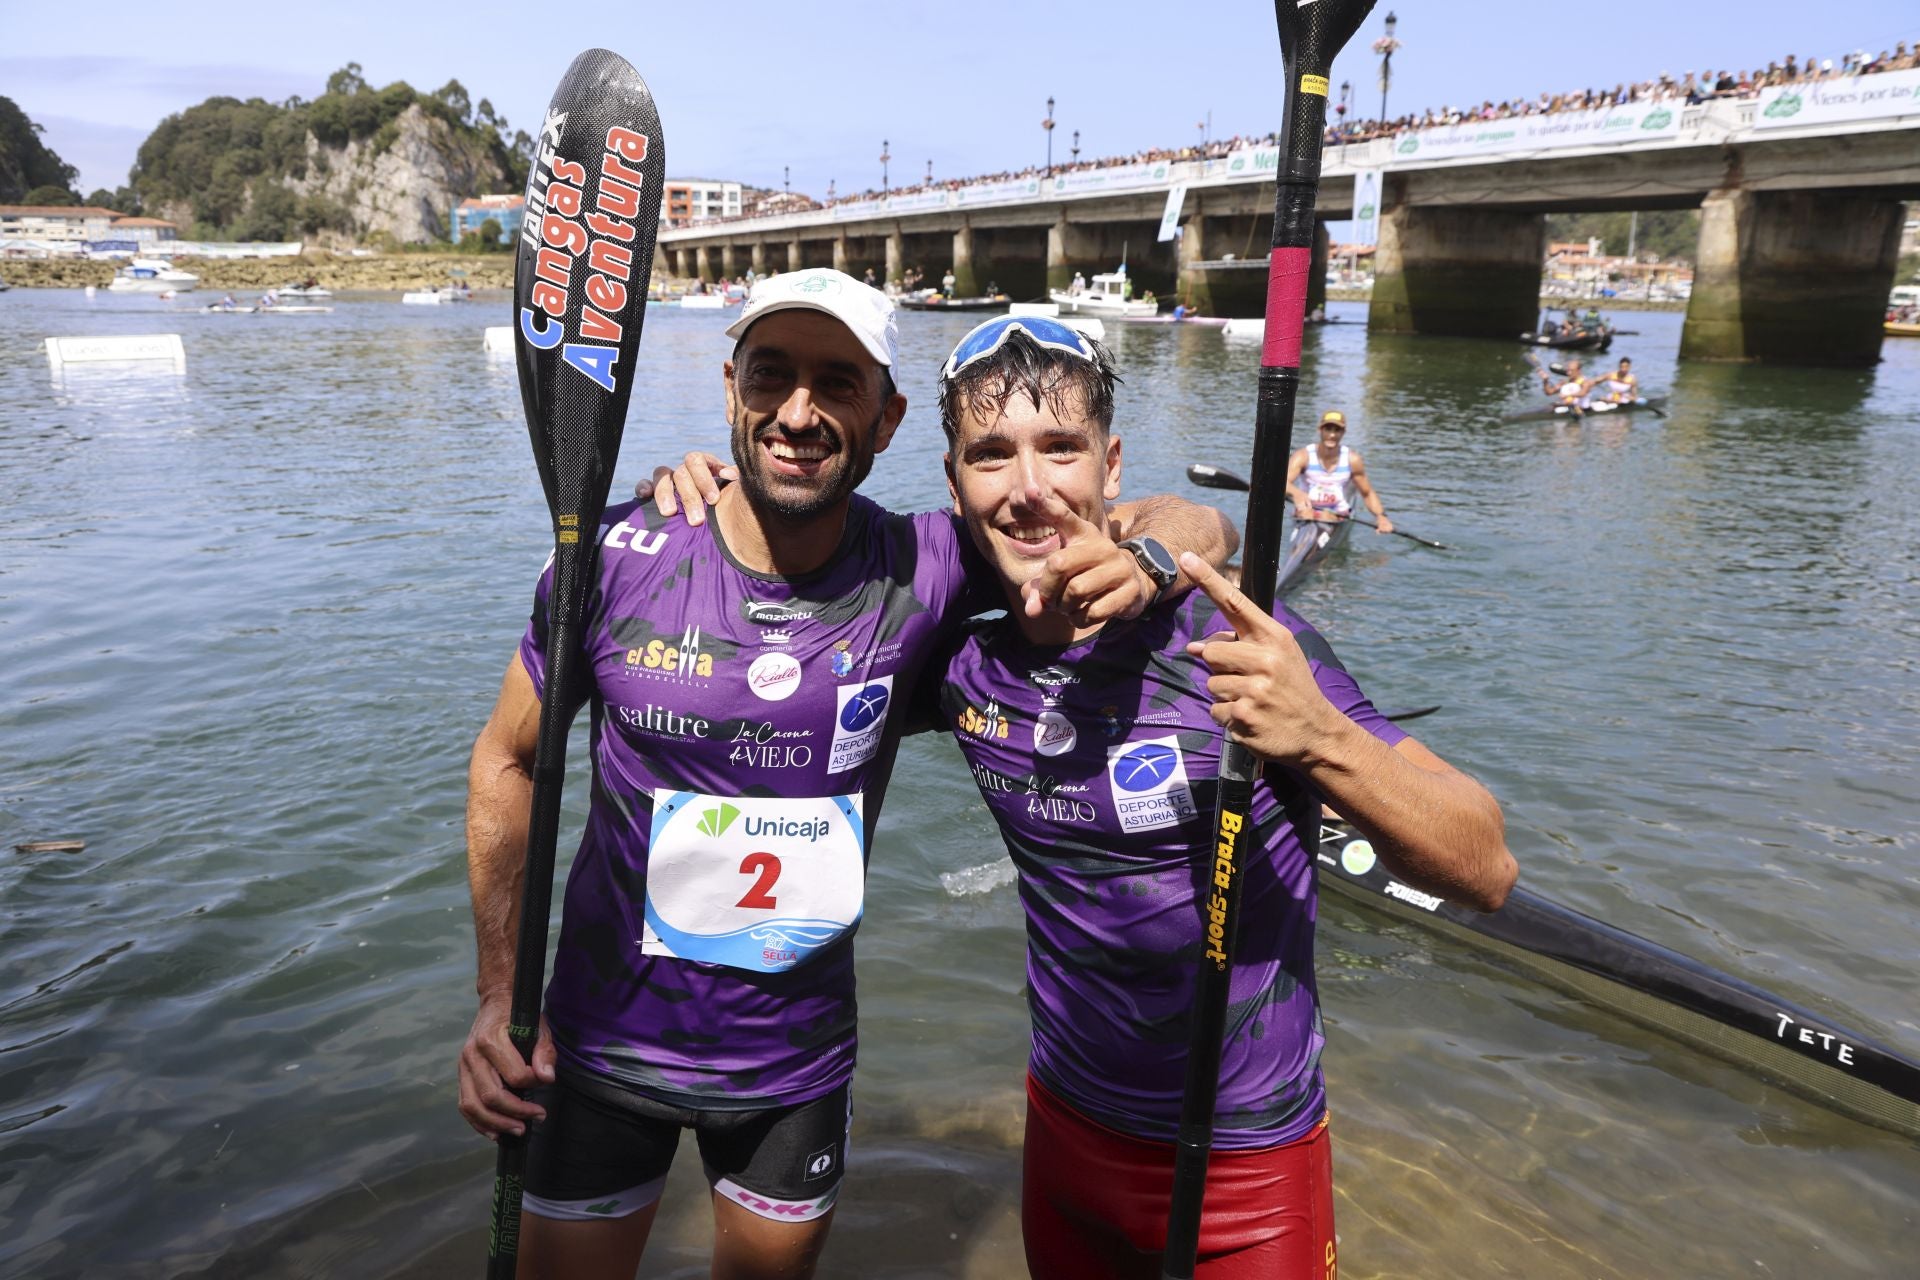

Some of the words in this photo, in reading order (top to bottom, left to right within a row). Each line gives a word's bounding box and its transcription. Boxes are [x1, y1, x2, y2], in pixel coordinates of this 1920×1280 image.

[1861, 88, 1888, 104] por
[520, 156, 588, 350] Cangas
[562, 126, 648, 393] Aventura
[626, 646, 644, 666] el
[643, 624, 713, 679] Sella
[625, 671, 709, 688] RIBADESELLA
[750, 664, 798, 685] Rialto
[619, 703, 709, 738] salitre
[730, 721, 755, 743] La
[755, 721, 814, 745] Casona
[834, 730, 881, 753] DEPORTE
[1037, 722, 1074, 744] Rialto
[745, 745, 812, 768] VIEJO
[832, 743, 878, 766] ASTURIANO
[973, 763, 1013, 792] litre
[1025, 775, 1040, 795] La
[1041, 775, 1090, 797] Casona
[1038, 798, 1096, 822] VIEJO
[1119, 793, 1189, 814] DEPORTE
[1124, 805, 1192, 826] ASTURIANO
[744, 816, 830, 843] Unicaja
[735, 851, 782, 910] 2
[764, 935, 785, 951] 87
[762, 950, 797, 961] SELLA
[1776, 1012, 1855, 1066] TETE
